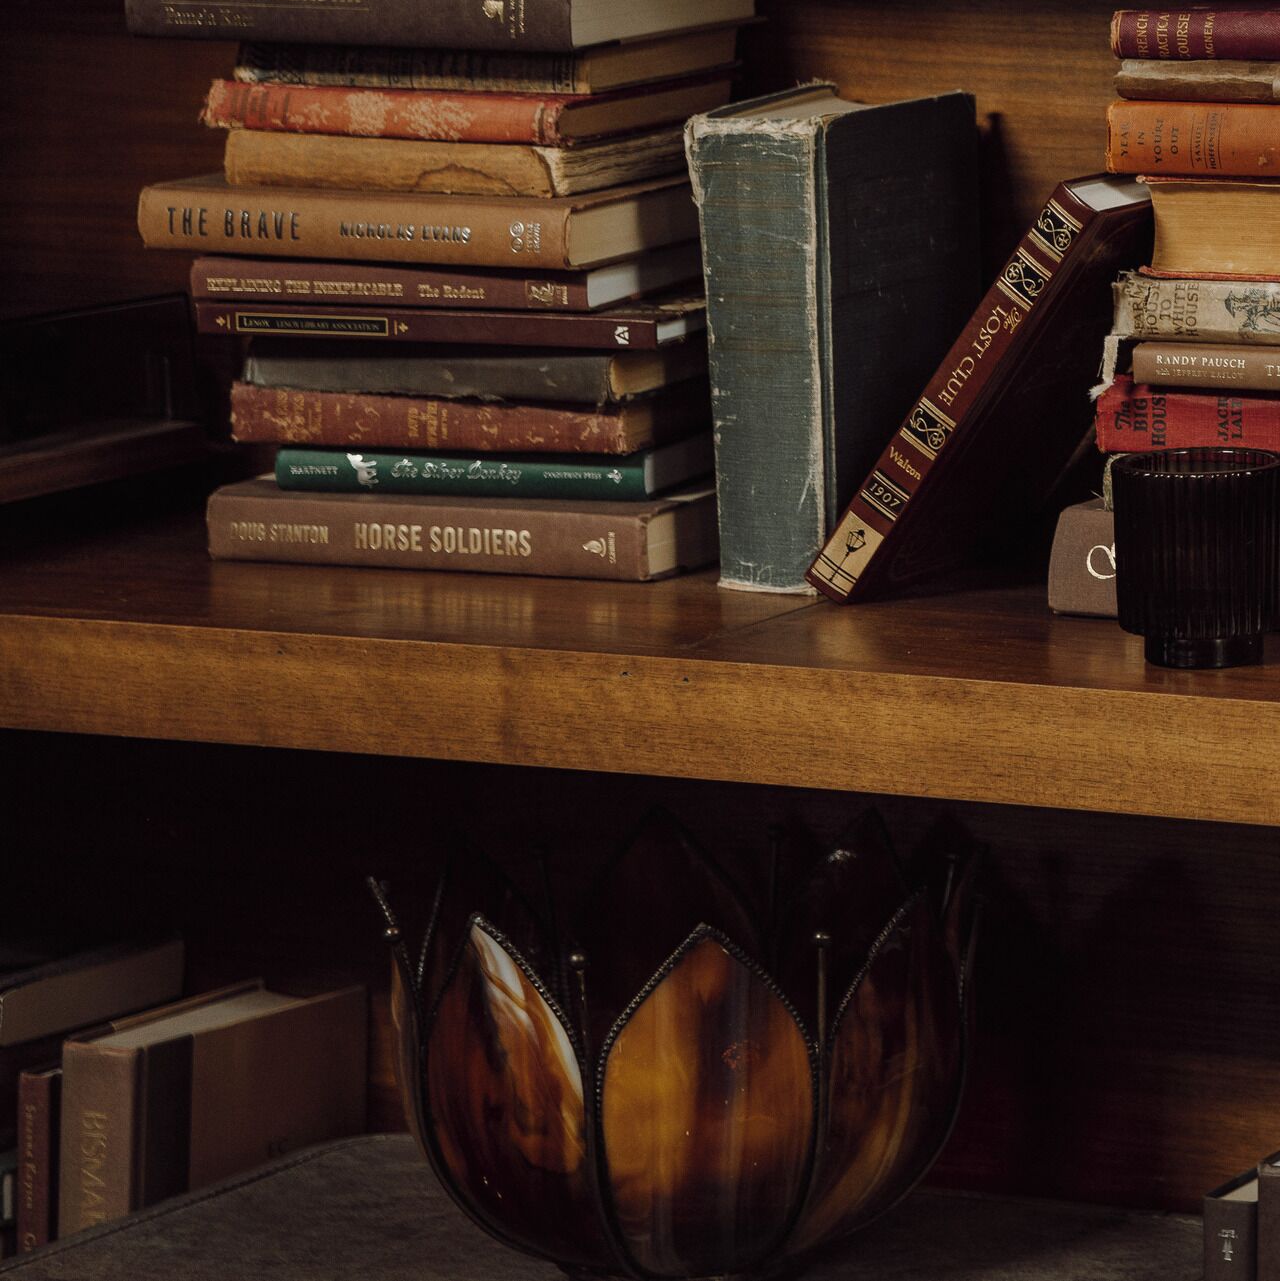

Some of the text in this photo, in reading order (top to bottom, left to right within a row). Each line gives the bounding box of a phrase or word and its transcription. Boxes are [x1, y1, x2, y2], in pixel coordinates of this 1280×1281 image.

[1120, 122, 1130, 157] YEAR
[1136, 131, 1145, 146] IN
[1170, 126, 1179, 155] OUT
[168, 207, 473, 245] THE BRAVE NICHOLAS EVANS
[206, 277, 487, 300] EXPLAINING THE INEXPLICABLE The Rodent
[242, 315, 271, 328] LENOX
[1145, 282, 1160, 336] HOUSE
[1159, 299, 1173, 321] TO
[1173, 283, 1186, 336] WHITE
[1186, 282, 1199, 337] HOUSE
[937, 303, 1023, 407] The LOST CLUE
[1156, 355, 1246, 369] RANDY PAUSCH
[1115, 400, 1132, 431] The
[1133, 398, 1148, 432] BIG
[390, 458, 419, 479] The
[420, 461, 467, 482] Silver
[889, 446, 922, 482] Walton
[869, 481, 902, 510] 1907
[230, 522, 532, 558] DOUG STANTON HORSE SOLDIERS
